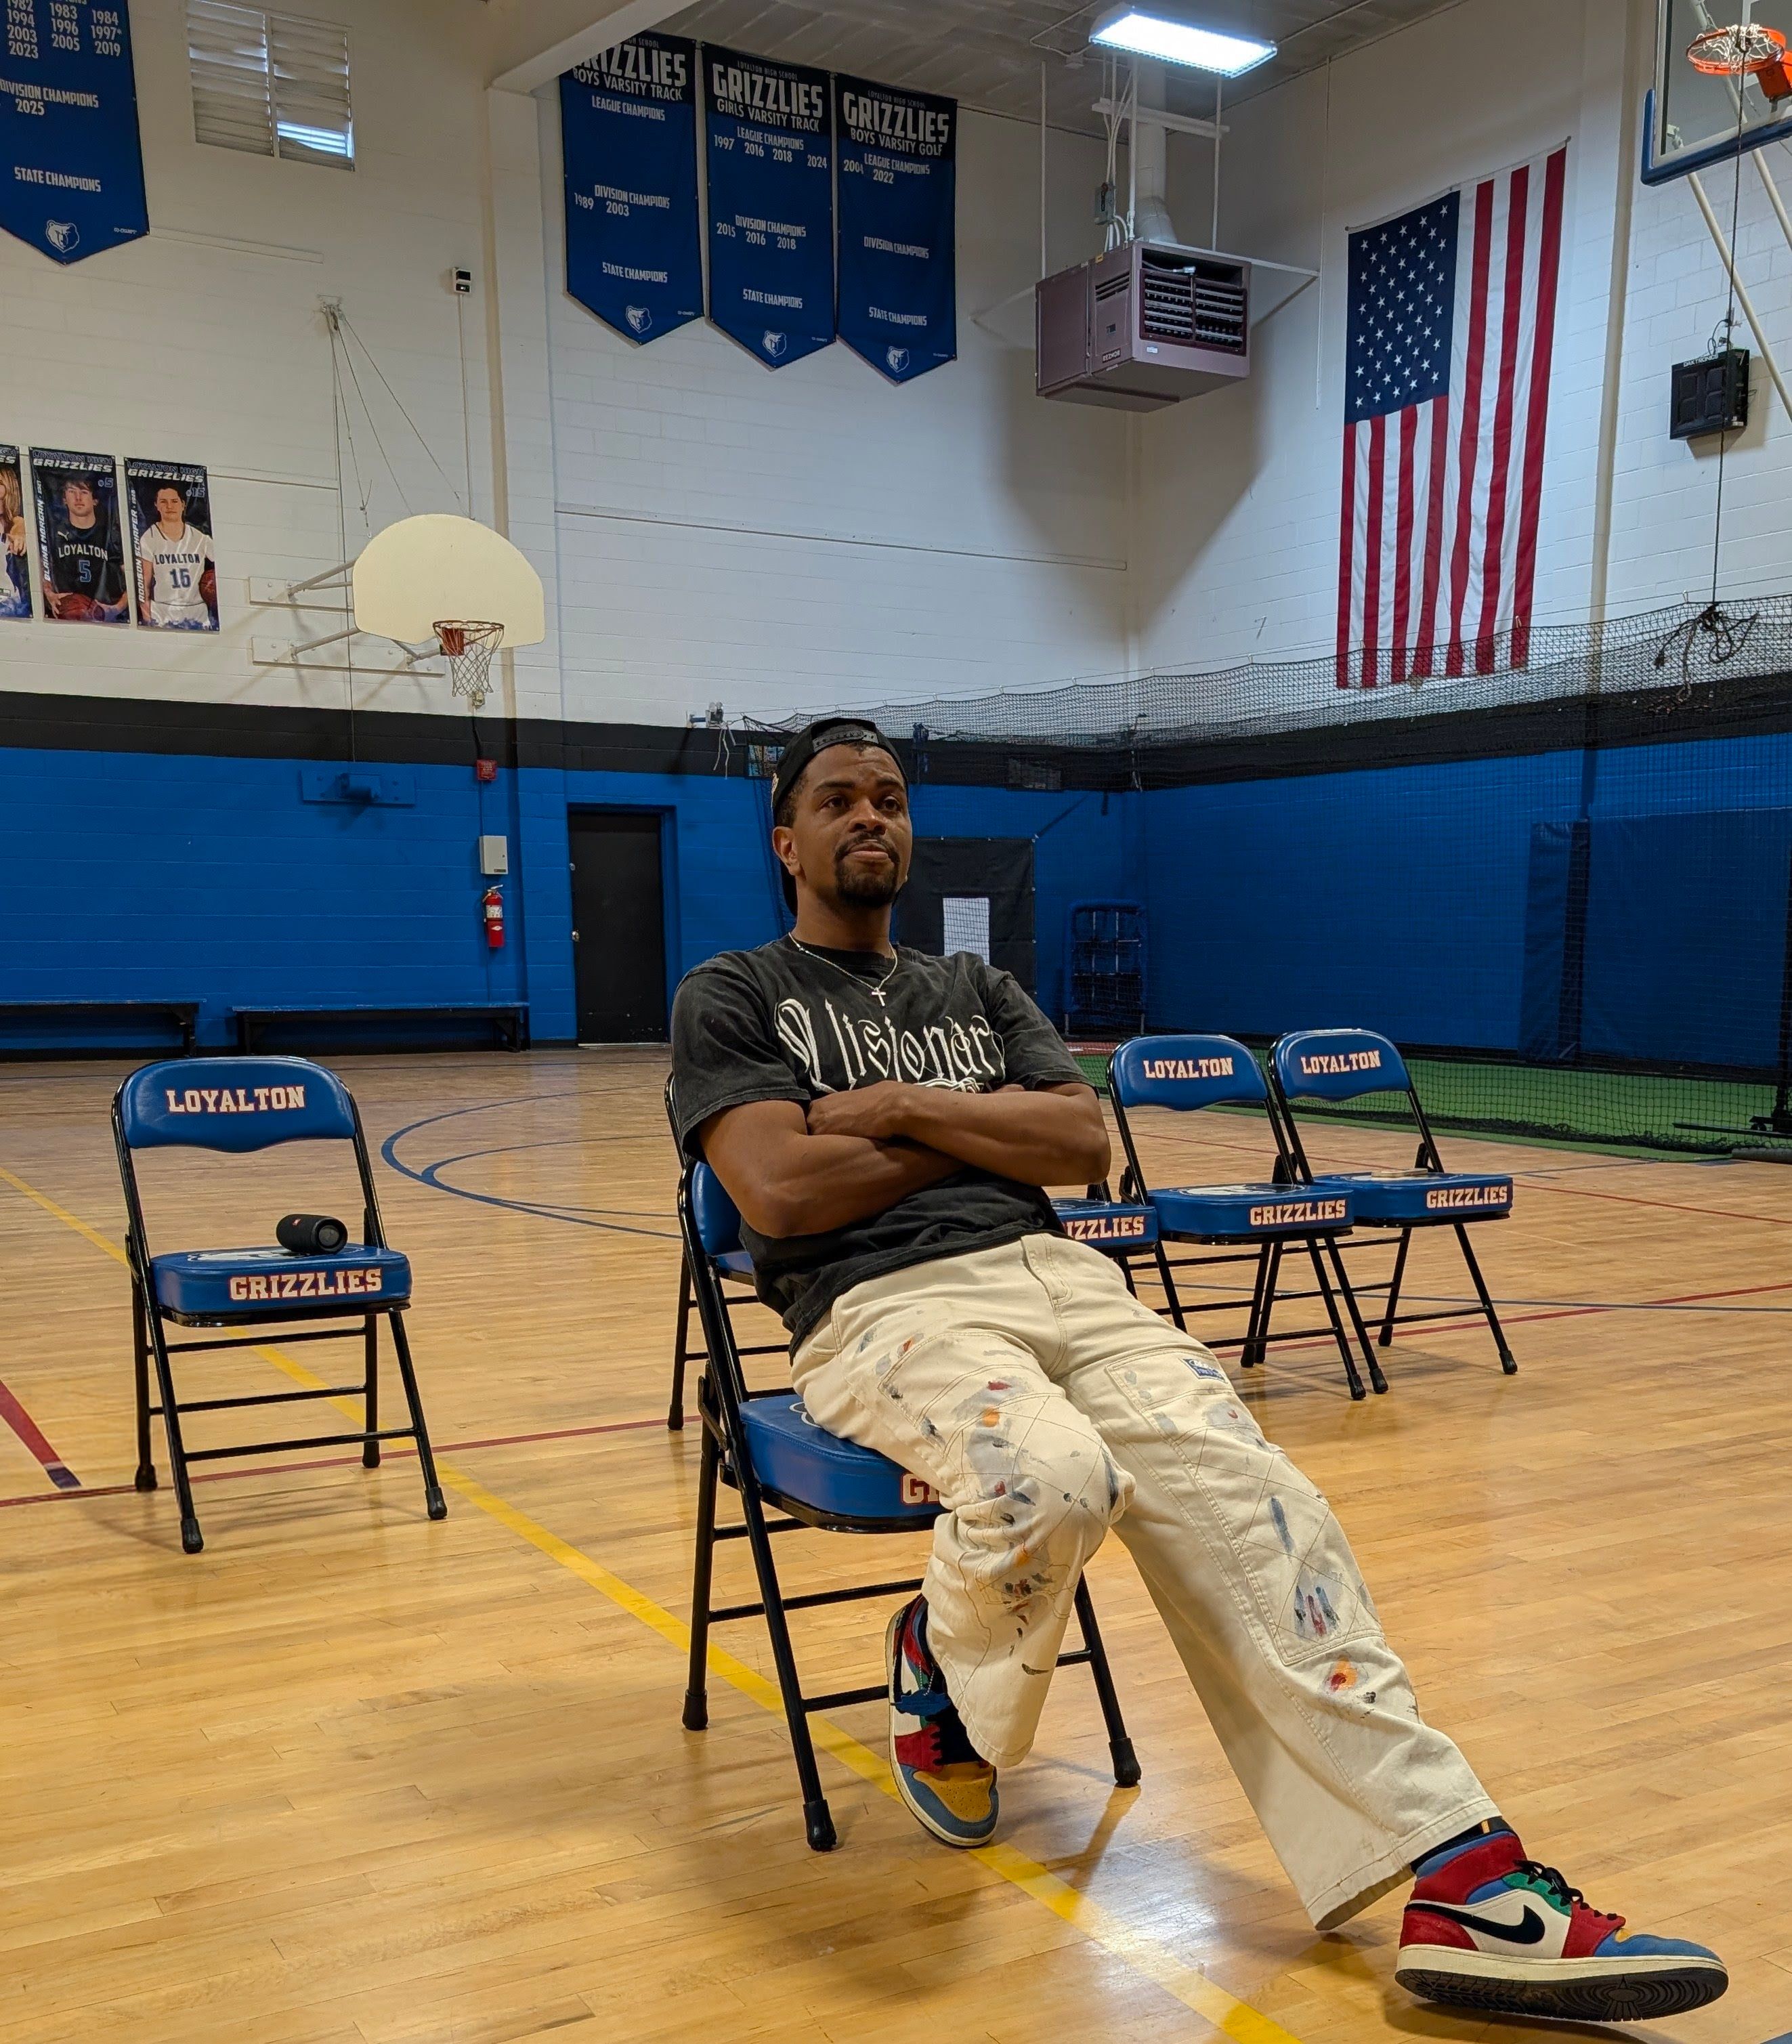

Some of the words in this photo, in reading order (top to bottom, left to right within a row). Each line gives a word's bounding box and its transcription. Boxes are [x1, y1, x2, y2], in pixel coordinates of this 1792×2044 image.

[7, 0, 34, 12] 1982
[49, 3, 78, 20] 1983
[7, 9, 35, 27] 1994
[51, 18, 79, 35] 1996
[92, 9, 119, 26] 1984
[7, 24, 38, 43] 2003
[51, 34, 80, 51] 2005
[8, 41, 39, 58] 2023
[94, 41, 121, 57] 2019
[0, 79, 41, 100] DIVISION
[43, 87, 99, 108] CHAMPIONS
[603, 74, 647, 95] VARSITY
[650, 84, 683, 101] TRACK
[712, 63, 823, 118] GRIZZLIES
[15, 98, 45, 116] 2025
[592, 95, 622, 113] LEAGUE
[622, 102, 666, 121] CHAMPIONS
[717, 98, 744, 118] GIRLS
[748, 106, 788, 127] VARSITY
[791, 115, 819, 132] TRACK
[843, 91, 949, 144] GRIZZLIES
[737, 126, 763, 144] LEAGUE
[765, 133, 804, 150] CHAMPIONS
[850, 127, 875, 145] BOYS
[879, 134, 916, 154] VARSITY
[919, 143, 943, 156] GOLF
[714, 134, 735, 150] 1997
[744, 142, 764, 156] 2016
[773, 148, 792, 163] 2018
[807, 154, 827, 169] 2024
[864, 152, 891, 169] LEAGUE
[891, 158, 930, 175] CHAMPIONS
[14, 167, 45, 185] STATE
[45, 171, 101, 192] CHAMPIONS
[873, 169, 894, 184] 2022
[574, 192, 594, 210] 1989
[606, 201, 629, 217] 2003
[595, 184, 628, 203] DIVISION
[629, 192, 670, 209] CHAMPIONS
[717, 222, 735, 237] 2015
[746, 231, 766, 246] 2016
[777, 236, 796, 250] 2018
[735, 215, 766, 232] DIVISION
[767, 221, 806, 237] CHAMPIONS
[863, 236, 893, 252] DIVISION
[894, 242, 929, 259] CHAMPIONS
[602, 261, 624, 278] STATE
[624, 268, 668, 283] CHAMPIONS
[743, 289, 763, 303] STATE
[765, 293, 803, 309] CHAMPIONS
[869, 307, 888, 320] STATE
[889, 312, 926, 326] CHAMPIONS
[33, 458, 112, 473] GRIZZLIES
[127, 461, 177, 473] LOYALTON
[127, 468, 204, 483] GRIZZLIES
[58, 543, 108, 561] LOYALTON
[154, 553, 200, 564] LOYALTON
[79, 559, 92, 582] 5
[1143, 1057, 1233, 1079] LOYALTON
[1301, 1050, 1382, 1074] LOYALTON
[165, 1085, 305, 1113] LOYALTON
[1426, 1185, 1508, 1209] GRIZZLIES
[1250, 1199, 1346, 1227] GRIZZLIES
[229, 1267, 383, 1301] GRIZZLIES
